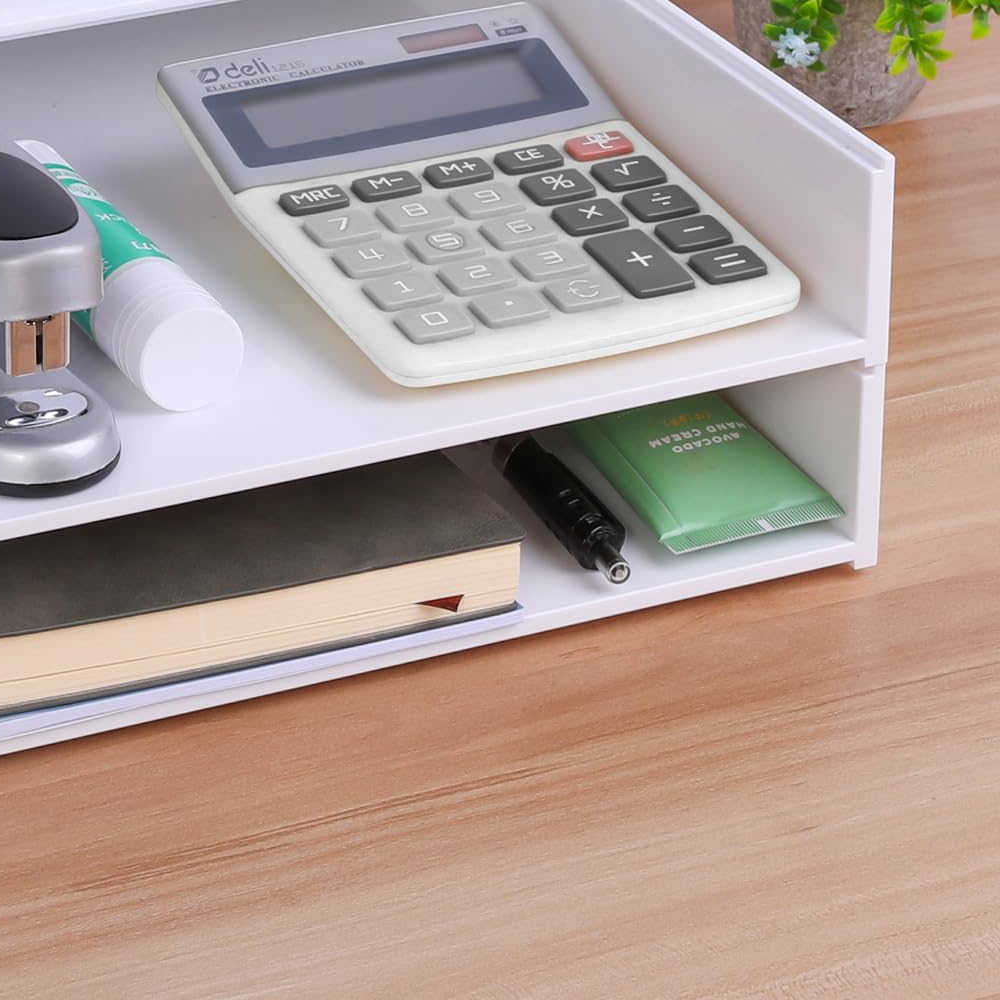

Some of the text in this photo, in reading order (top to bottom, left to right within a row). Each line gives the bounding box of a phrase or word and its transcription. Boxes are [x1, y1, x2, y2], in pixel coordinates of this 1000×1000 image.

[224, 57, 271, 80] deli
[205, 59, 366, 94] ELECTRONIC CALCULATOR
[513, 148, 545, 162] CE
[290, 187, 342, 205] MRC
[474, 189, 501, 204] 9
[401, 203, 428, 217] 8
[328, 216, 348, 232] 7
[505, 219, 534, 234] 6
[430, 232, 460, 247] 5
[358, 248, 385, 261] 4
[537, 251, 564, 265] 3
[464, 264, 493, 279] 2
[393, 280, 415, 293] 1
[648, 428, 703, 449] CREAM
[672, 431, 741, 454] AVOCADO
